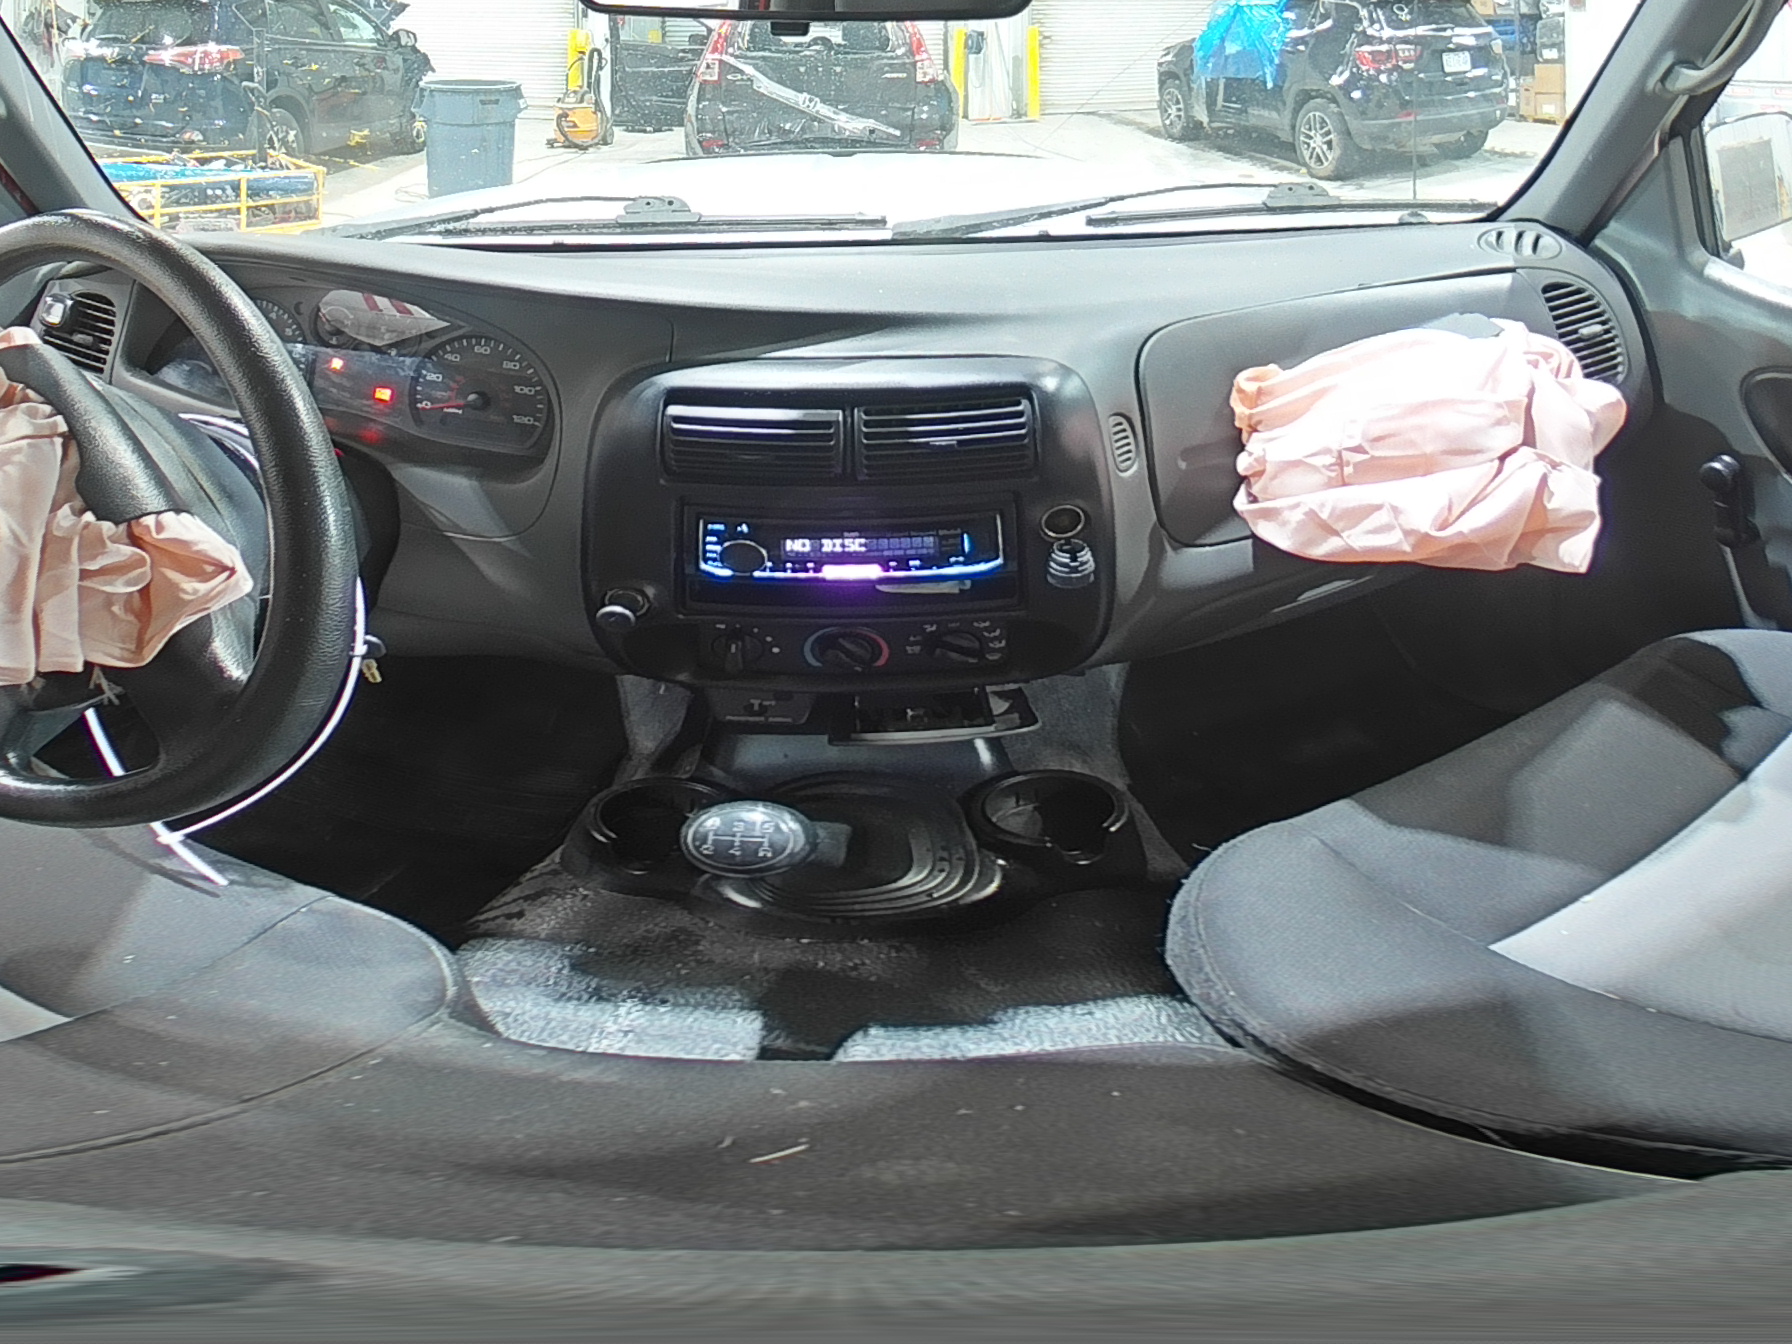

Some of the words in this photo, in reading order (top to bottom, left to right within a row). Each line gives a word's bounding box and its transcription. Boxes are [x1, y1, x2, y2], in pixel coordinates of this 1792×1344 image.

[474, 345, 491, 355] 60
[444, 352, 461, 362] 40
[502, 360, 520, 370] 80
[425, 372, 443, 382] 20
[513, 385, 536, 395] 100
[512, 414, 534, 425] 120
[785, 538, 811, 552] NO
[821, 538, 867, 553] DISC
